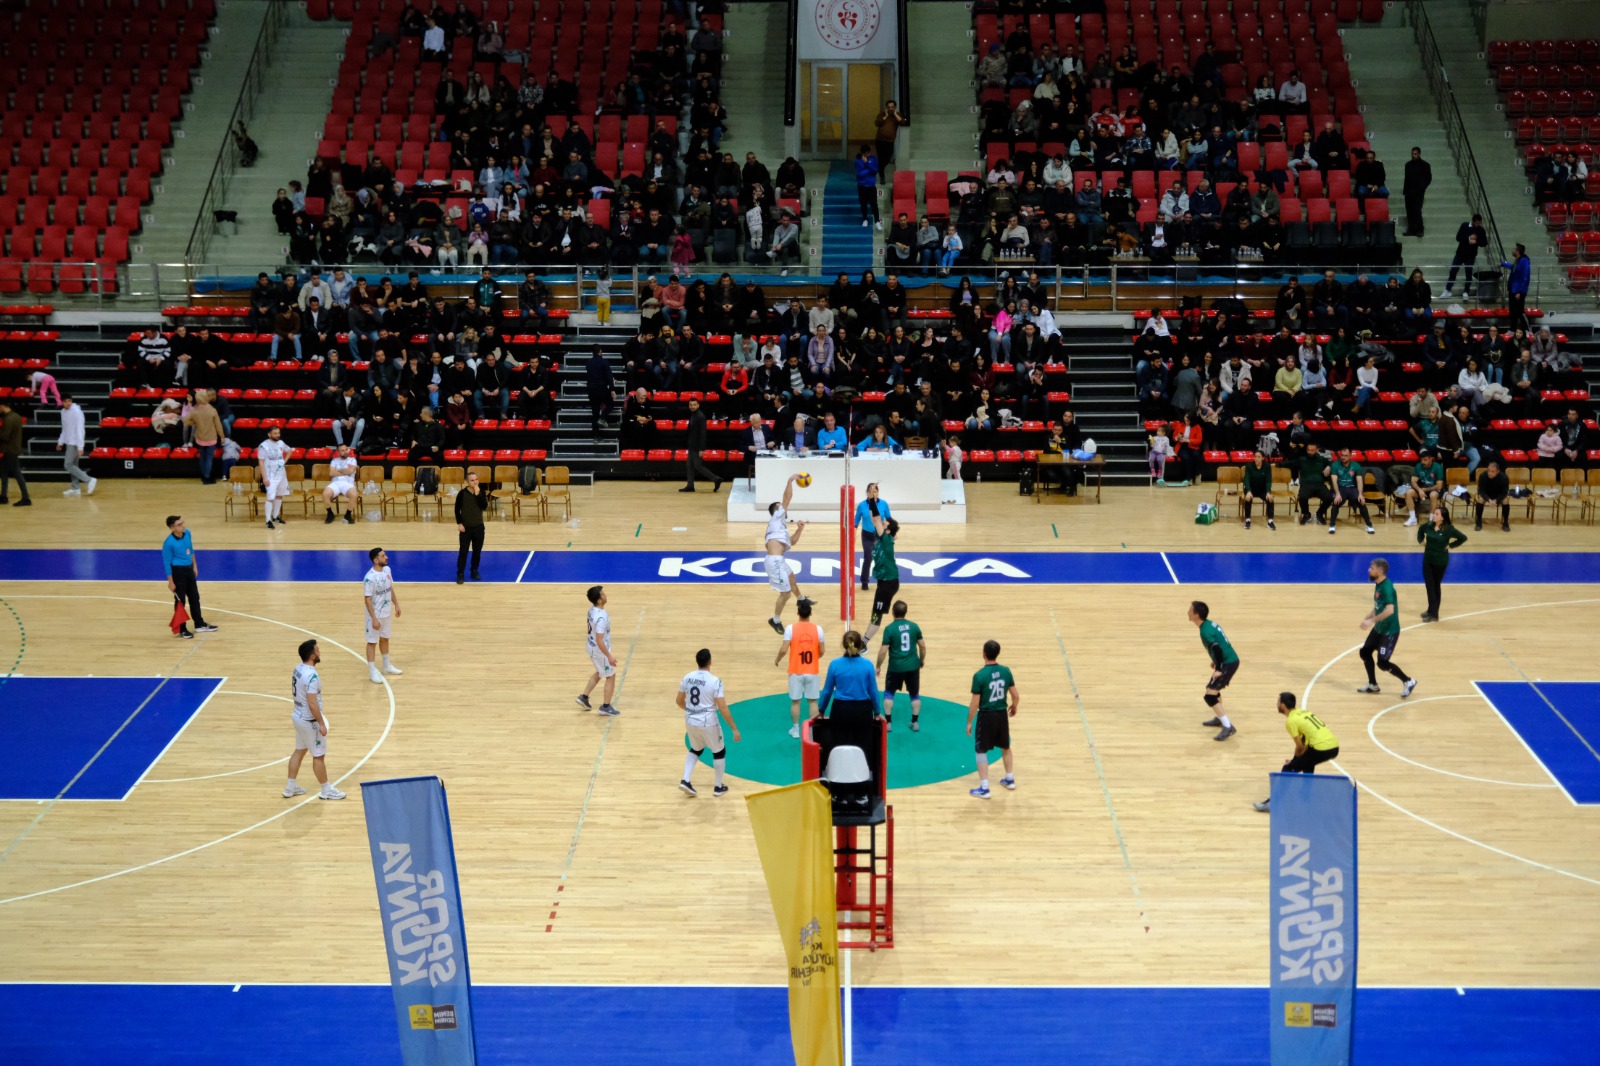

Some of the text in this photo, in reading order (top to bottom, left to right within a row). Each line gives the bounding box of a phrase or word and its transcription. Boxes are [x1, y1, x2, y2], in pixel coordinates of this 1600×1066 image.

[658, 556, 1032, 577] KONYA
[901, 632, 910, 652] 9
[798, 650, 813, 665] 10
[690, 686, 701, 706] 8
[988, 679, 1006, 703] 26
[1304, 714, 1326, 729] 10
